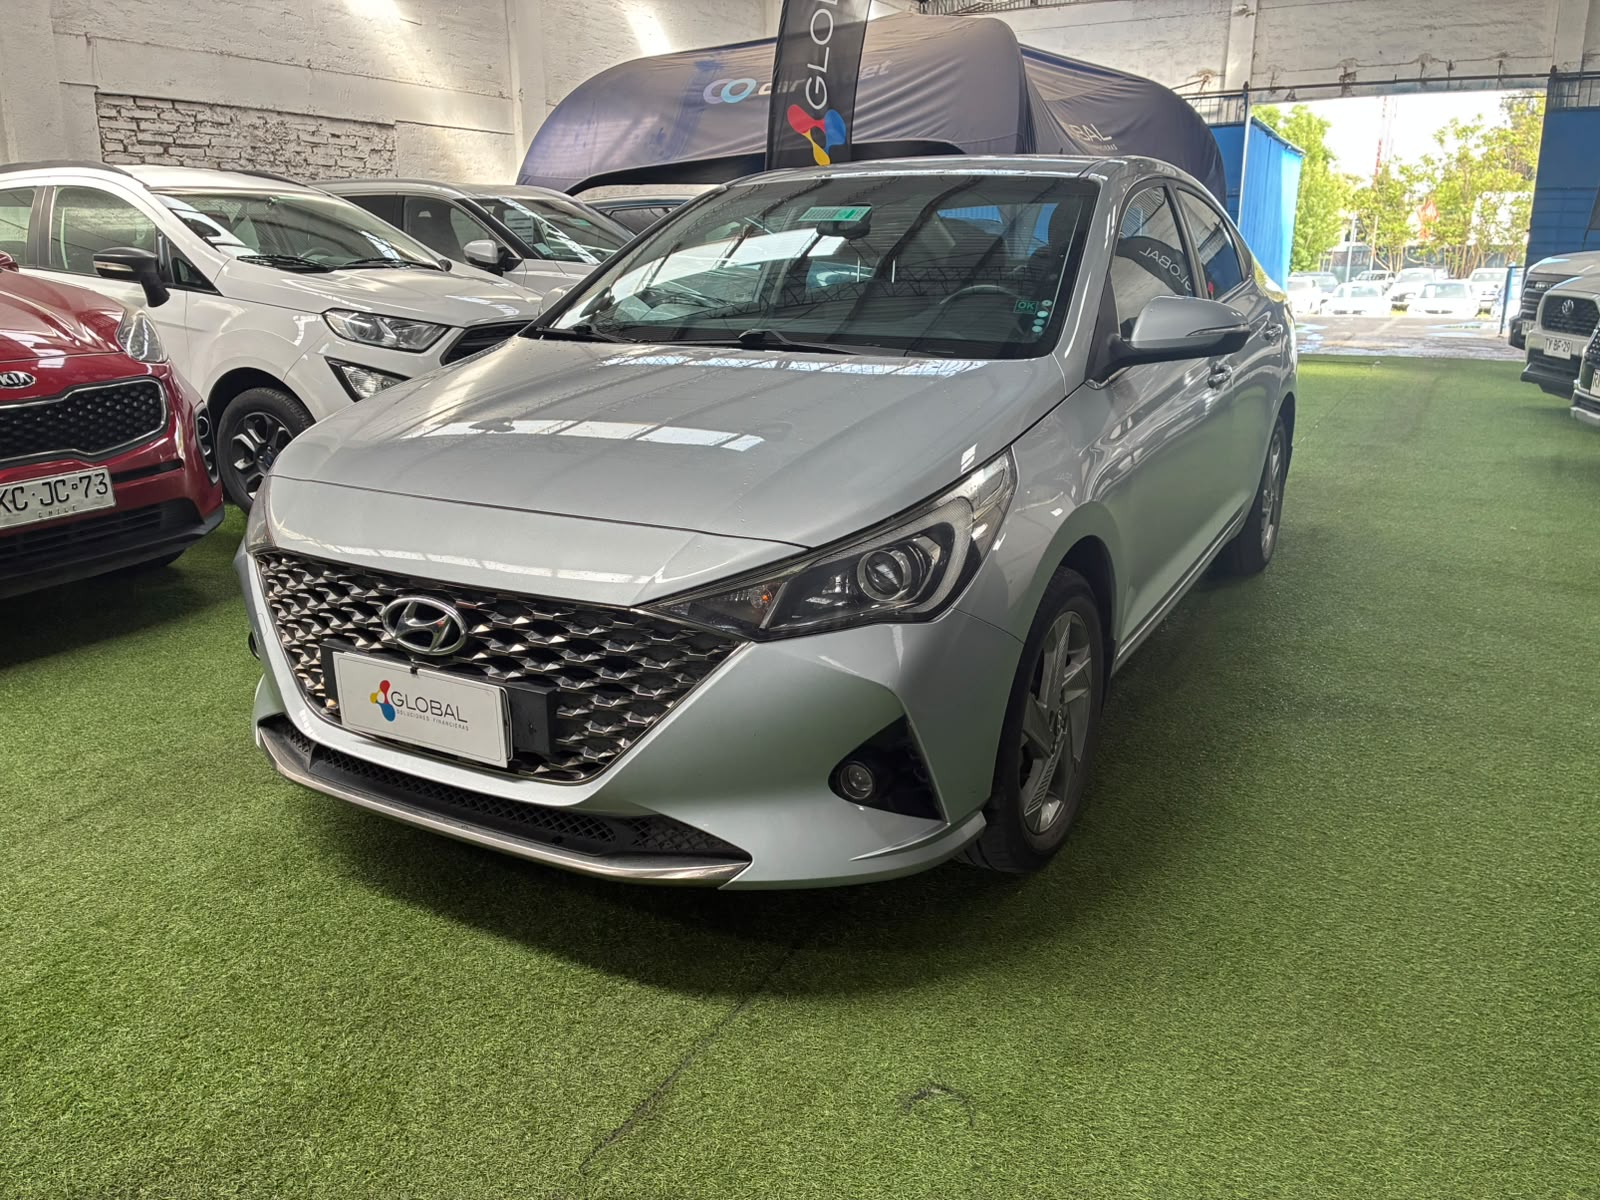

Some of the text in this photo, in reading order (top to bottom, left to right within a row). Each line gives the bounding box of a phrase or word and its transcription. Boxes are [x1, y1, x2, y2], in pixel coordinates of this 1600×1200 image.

[805, 0, 838, 110] GLO
[1067, 123, 1112, 142] BAL
[1017, 301, 1035, 310] OK
[391, 691, 468, 723] GLOBAL
[396, 709, 469, 731] SOLUCIONES FINANCIERAS
